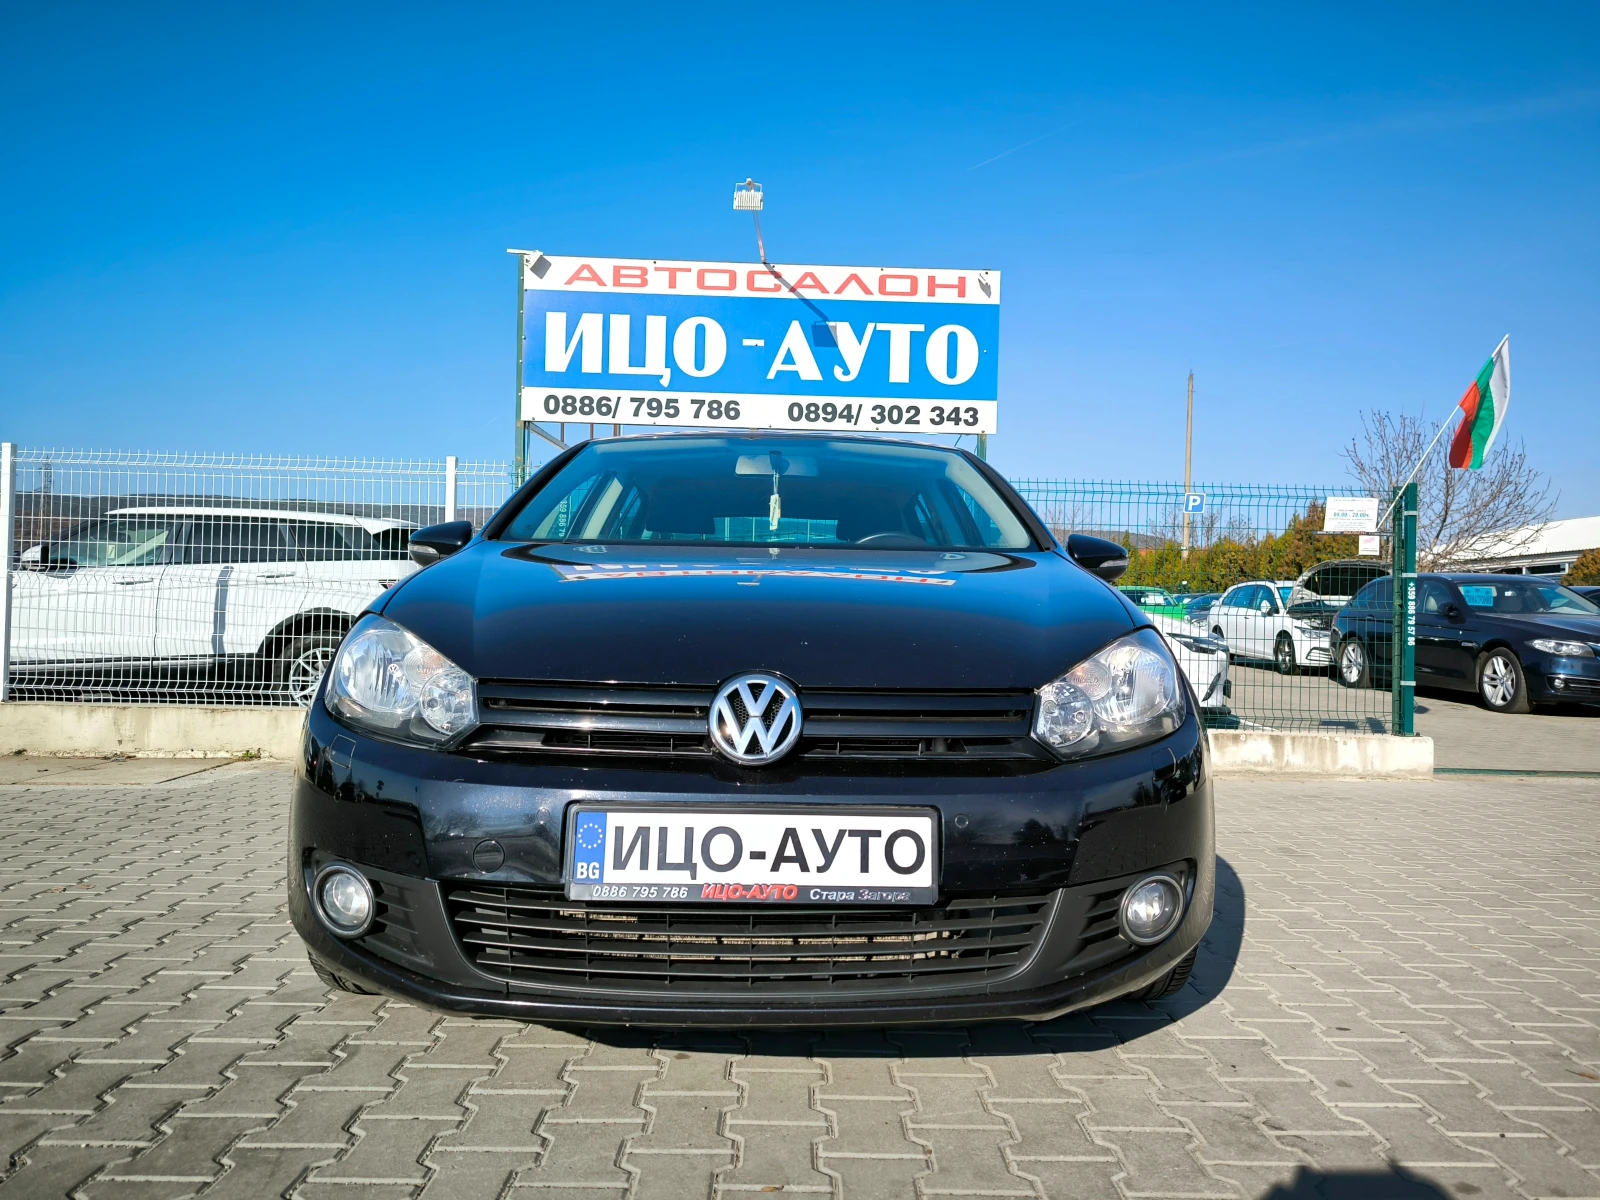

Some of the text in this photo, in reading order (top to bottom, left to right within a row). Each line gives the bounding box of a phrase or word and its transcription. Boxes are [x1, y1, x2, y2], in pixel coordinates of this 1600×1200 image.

[566, 264, 966, 298] АВТОСАЛОН
[543, 394, 741, 421] 0886/ 795 786
[787, 402, 979, 427] 0894/ 302 343
[1188, 494, 1201, 511] P
[1407, 582, 1416, 646] +359 886 79 57 86
[612, 826, 926, 881] ИЦО-АУТО
[576, 861, 600, 880] BG
[592, 885, 628, 899] 0886
[631, 886, 660, 899] 795
[662, 886, 689, 899] 786
[701, 883, 799, 901] ИЦО-АУТО
[809, 888, 855, 902] Стара
